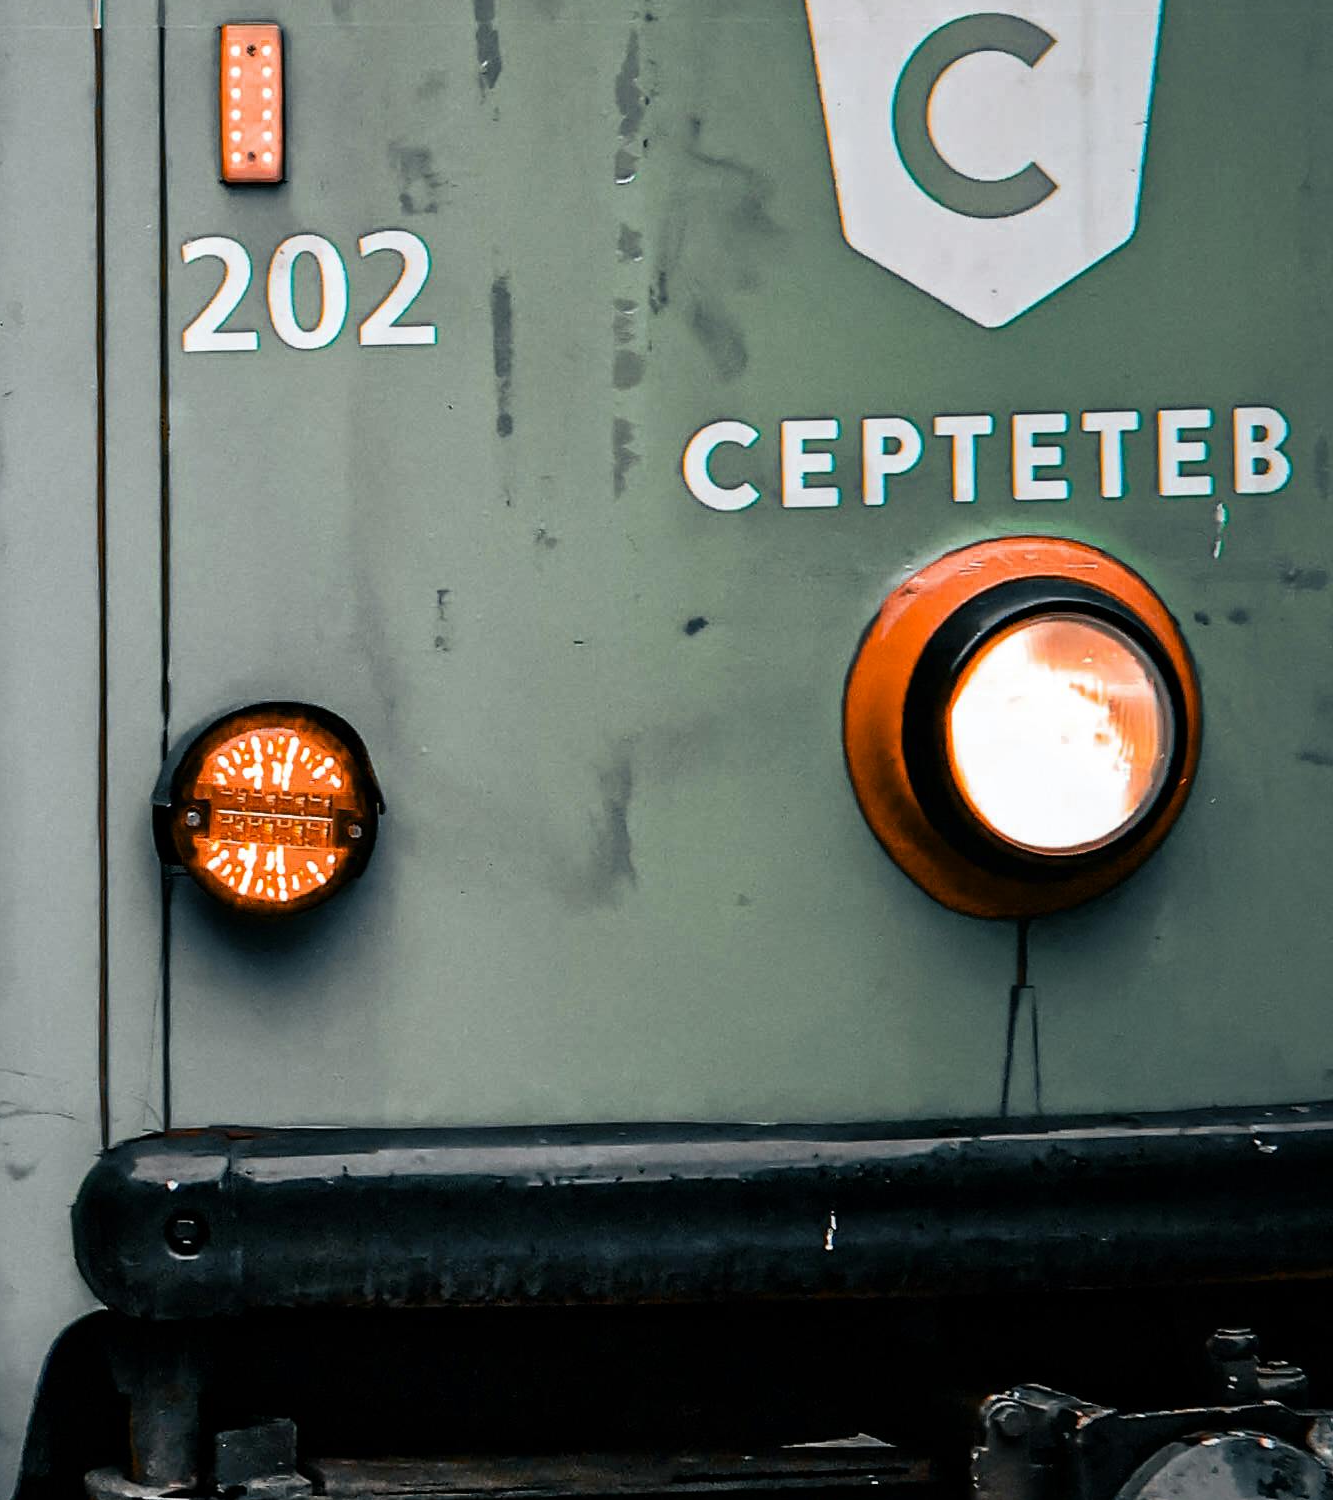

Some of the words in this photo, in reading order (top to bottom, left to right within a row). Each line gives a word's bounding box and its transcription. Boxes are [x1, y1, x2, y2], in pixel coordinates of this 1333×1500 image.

[891, 12, 1060, 220] C
[180, 230, 438, 353] 202
[682, 406, 1293, 512] CEPTETEB
